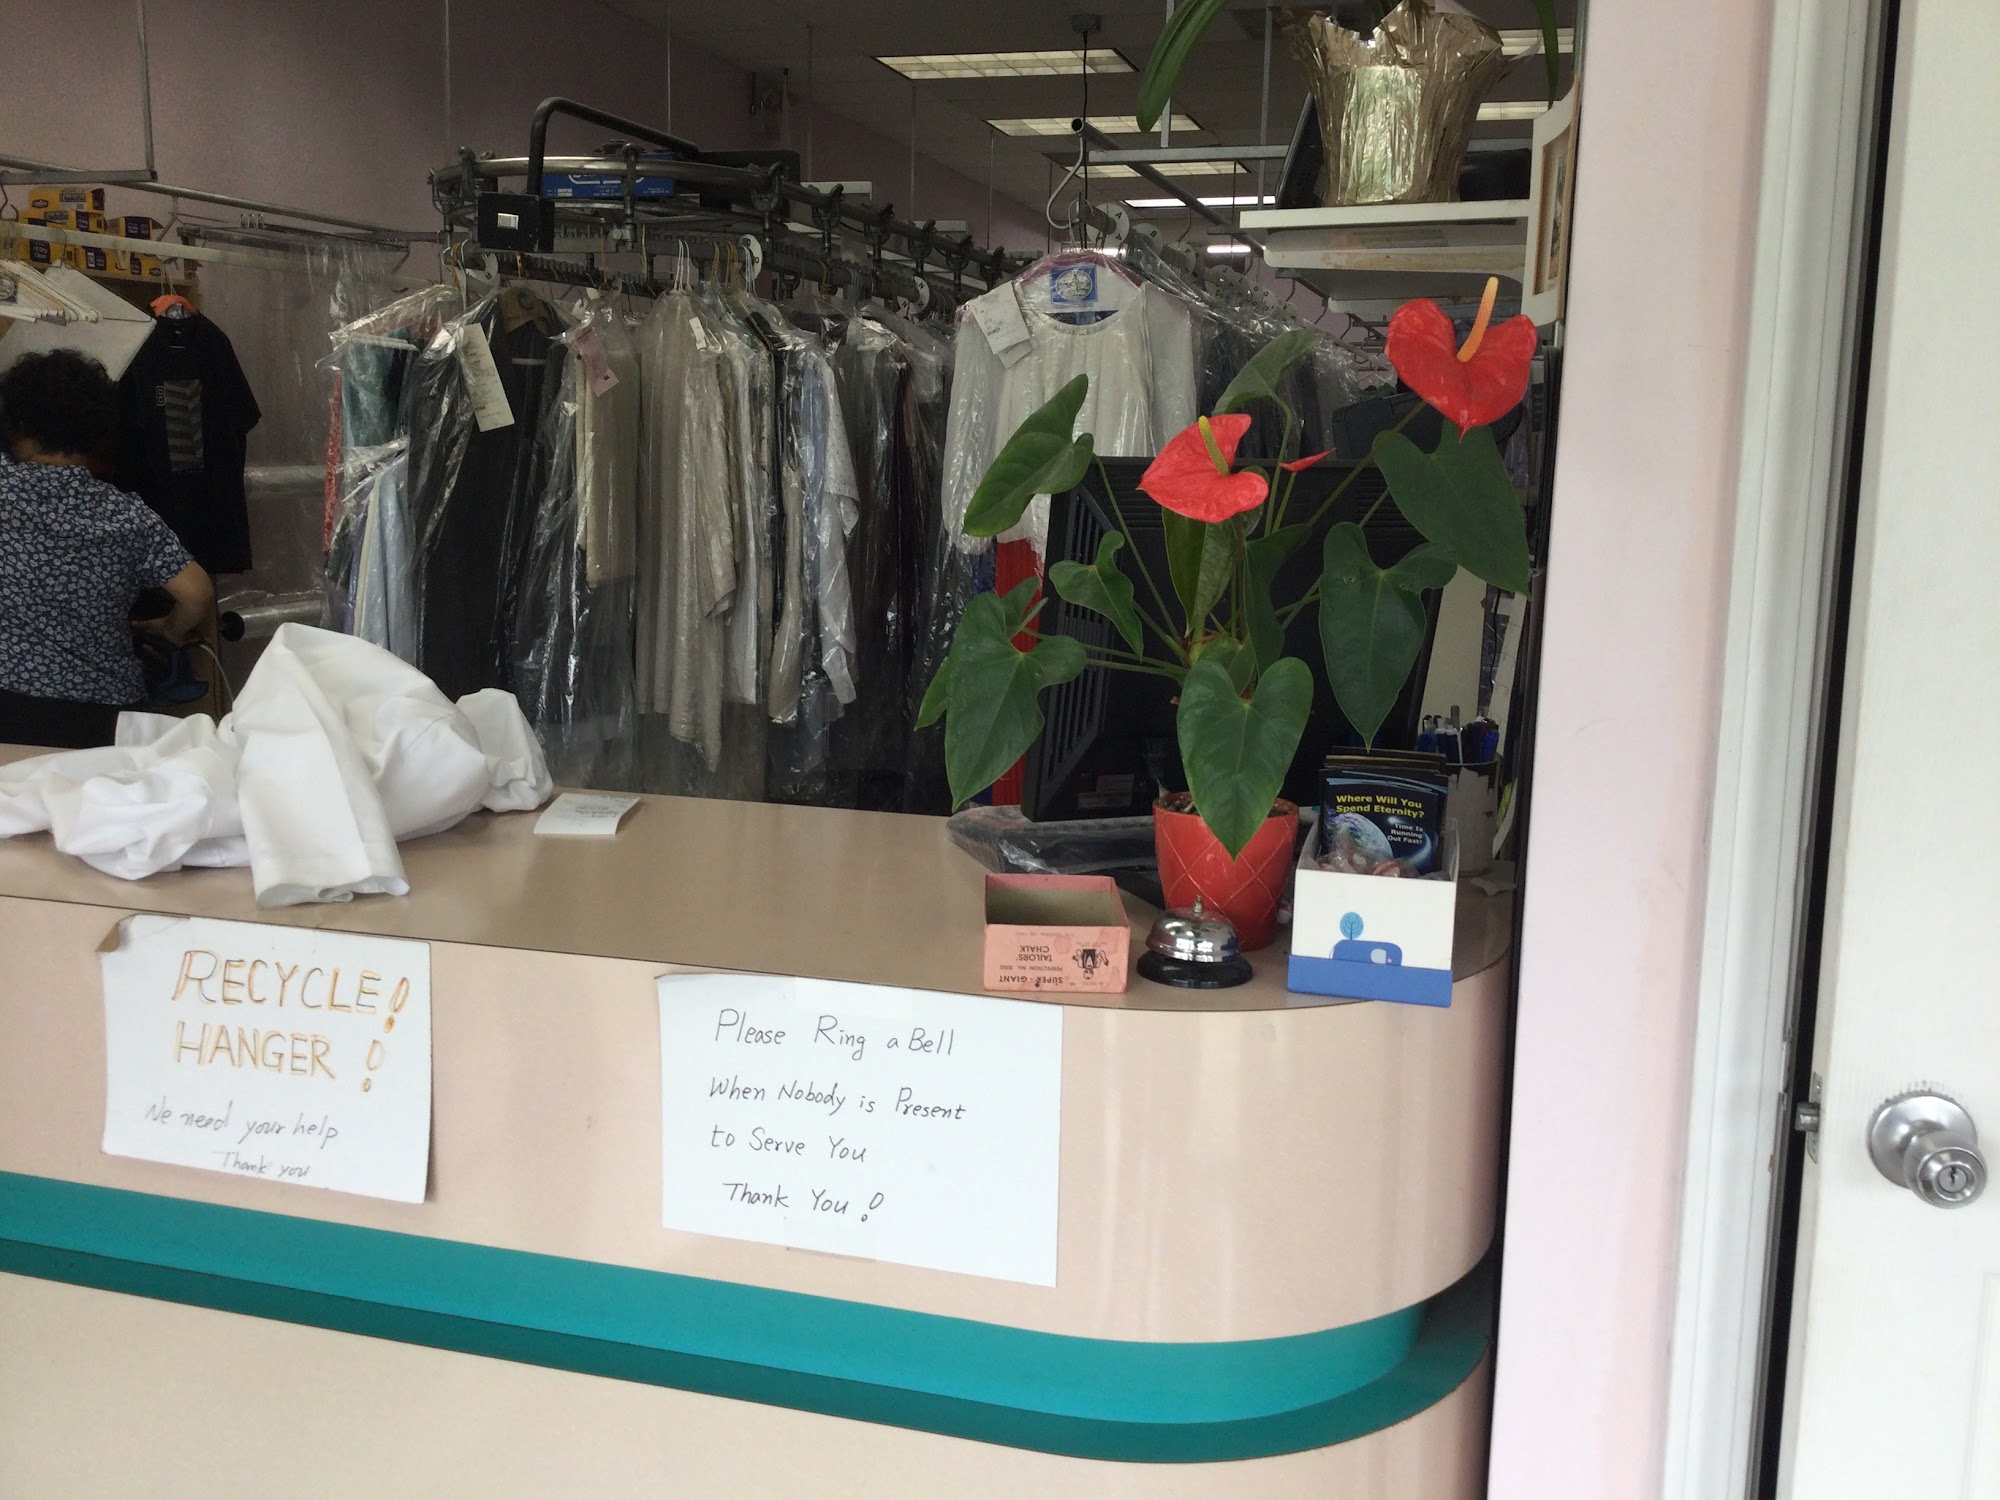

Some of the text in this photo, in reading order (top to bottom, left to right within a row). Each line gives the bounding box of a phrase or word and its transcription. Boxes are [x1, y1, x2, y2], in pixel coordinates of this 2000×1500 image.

[1115, 232, 1122, 241] A
[1150, 230, 1158, 238] B
[1335, 794, 1422, 809] Where Will You
[1335, 804, 1425, 819] Spend Eternity?
[1391, 829, 1423, 839] Running
[1395, 823, 1414, 831] Time
[1020, 945, 1050, 953] CHALK
[1016, 953, 1053, 962] TAILORS'
[999, 975, 1028, 983] GIANT
[1036, 976, 1064, 984] SUPER
[715, 1008, 954, 1061] Please Ring a Bell
[175, 1020, 336, 1080] HANGER
[709, 1075, 967, 1121] When Nobody is Present
[180, 1100, 233, 1132] need
[238, 1117, 286, 1145] your
[292, 1113, 338, 1149] help
[711, 1124, 867, 1163] to Serve You
[212, 1151, 312, 1178] Thank you
[722, 1182, 790, 1209] Thank
[811, 1188, 849, 1216] You
